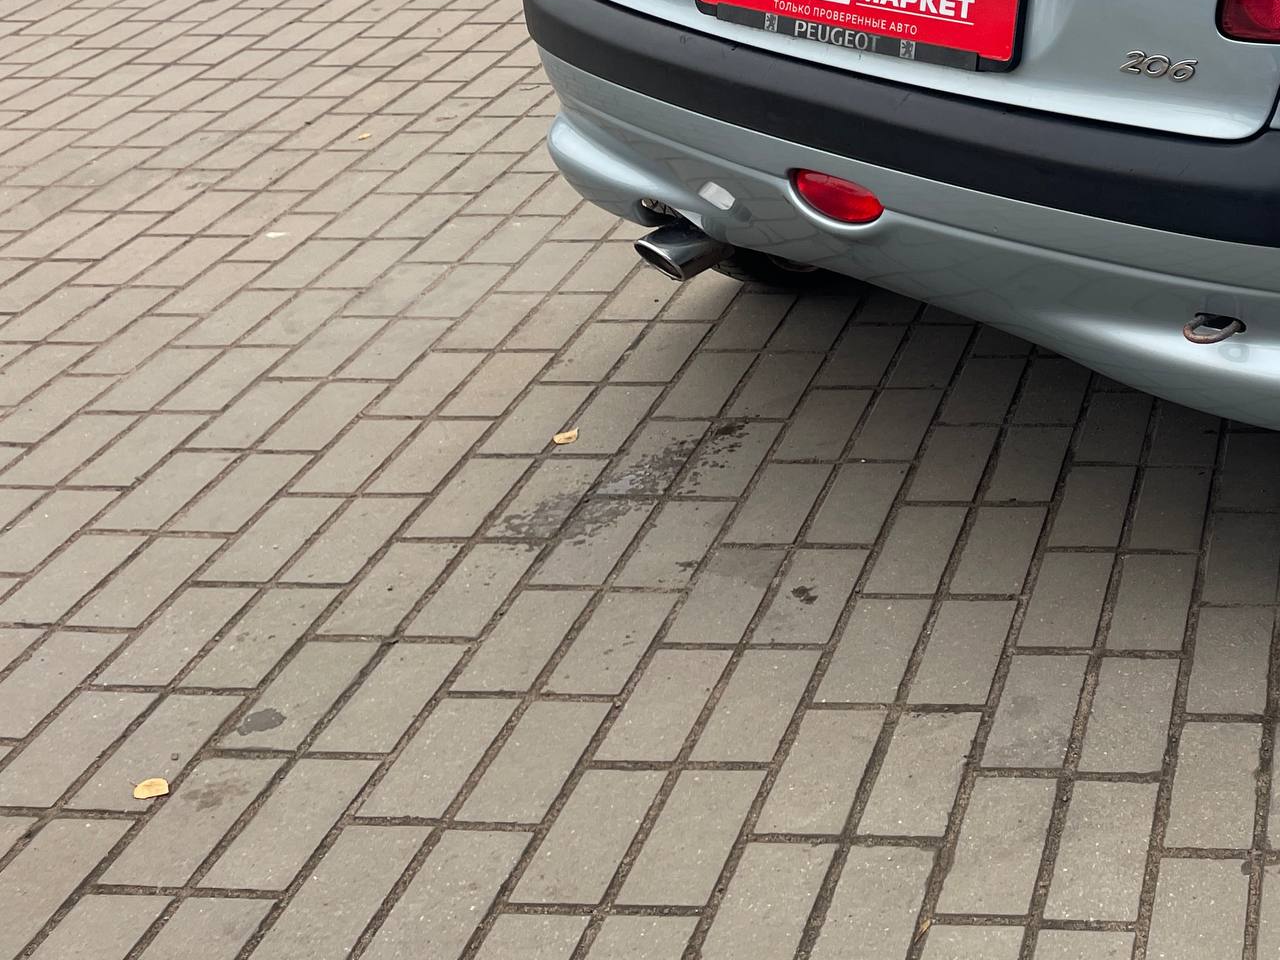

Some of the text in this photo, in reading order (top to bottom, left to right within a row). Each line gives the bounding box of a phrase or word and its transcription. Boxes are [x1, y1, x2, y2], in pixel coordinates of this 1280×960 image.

[773, 0, 918, 36] ТОЛЬКО ПРОВЕРЕННЫЕ АВТО
[794, 20, 881, 53] PEUGEOT
[1120, 49, 1199, 82] 206
